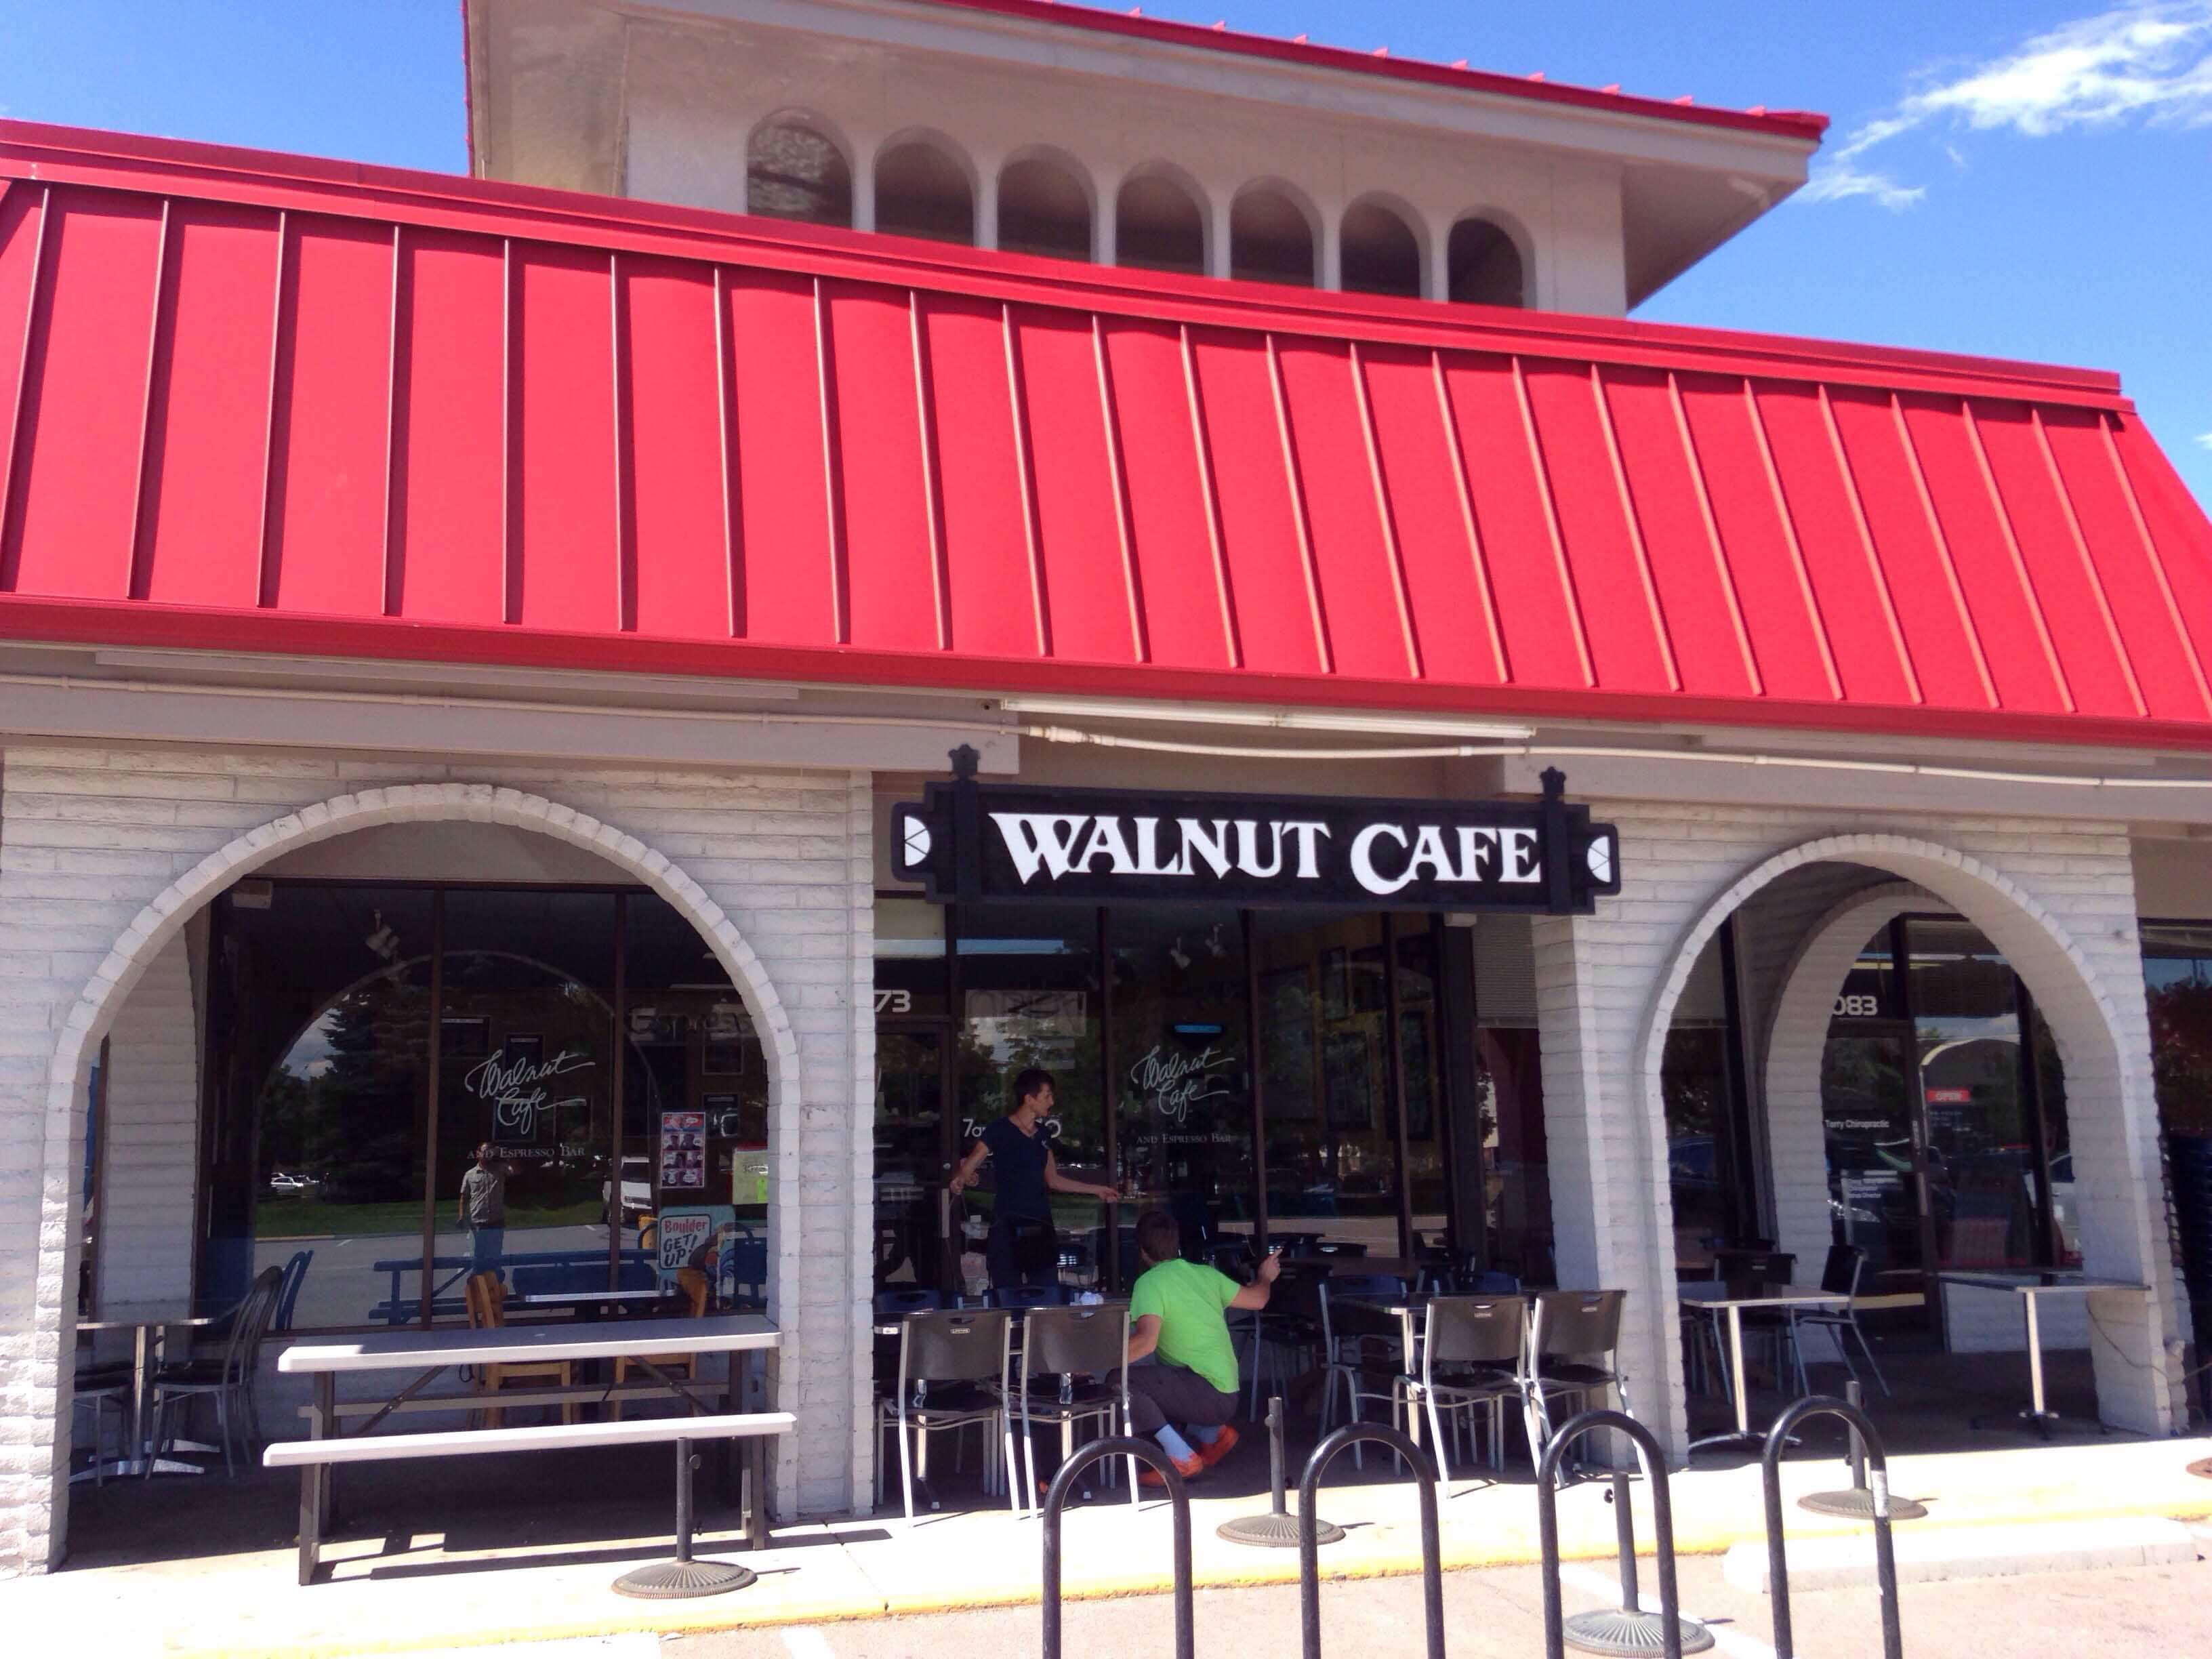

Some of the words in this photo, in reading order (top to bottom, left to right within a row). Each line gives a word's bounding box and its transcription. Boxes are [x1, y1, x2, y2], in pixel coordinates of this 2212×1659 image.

[989, 813, 1330, 884] WALNUT
[1350, 823, 1541, 895] CAFE
[875, 989, 911, 1012] 73
[465, 1049, 596, 1099] Walnut
[1130, 1044, 1235, 1090] Walnut
[664, 1218, 707, 1233] Boulder
